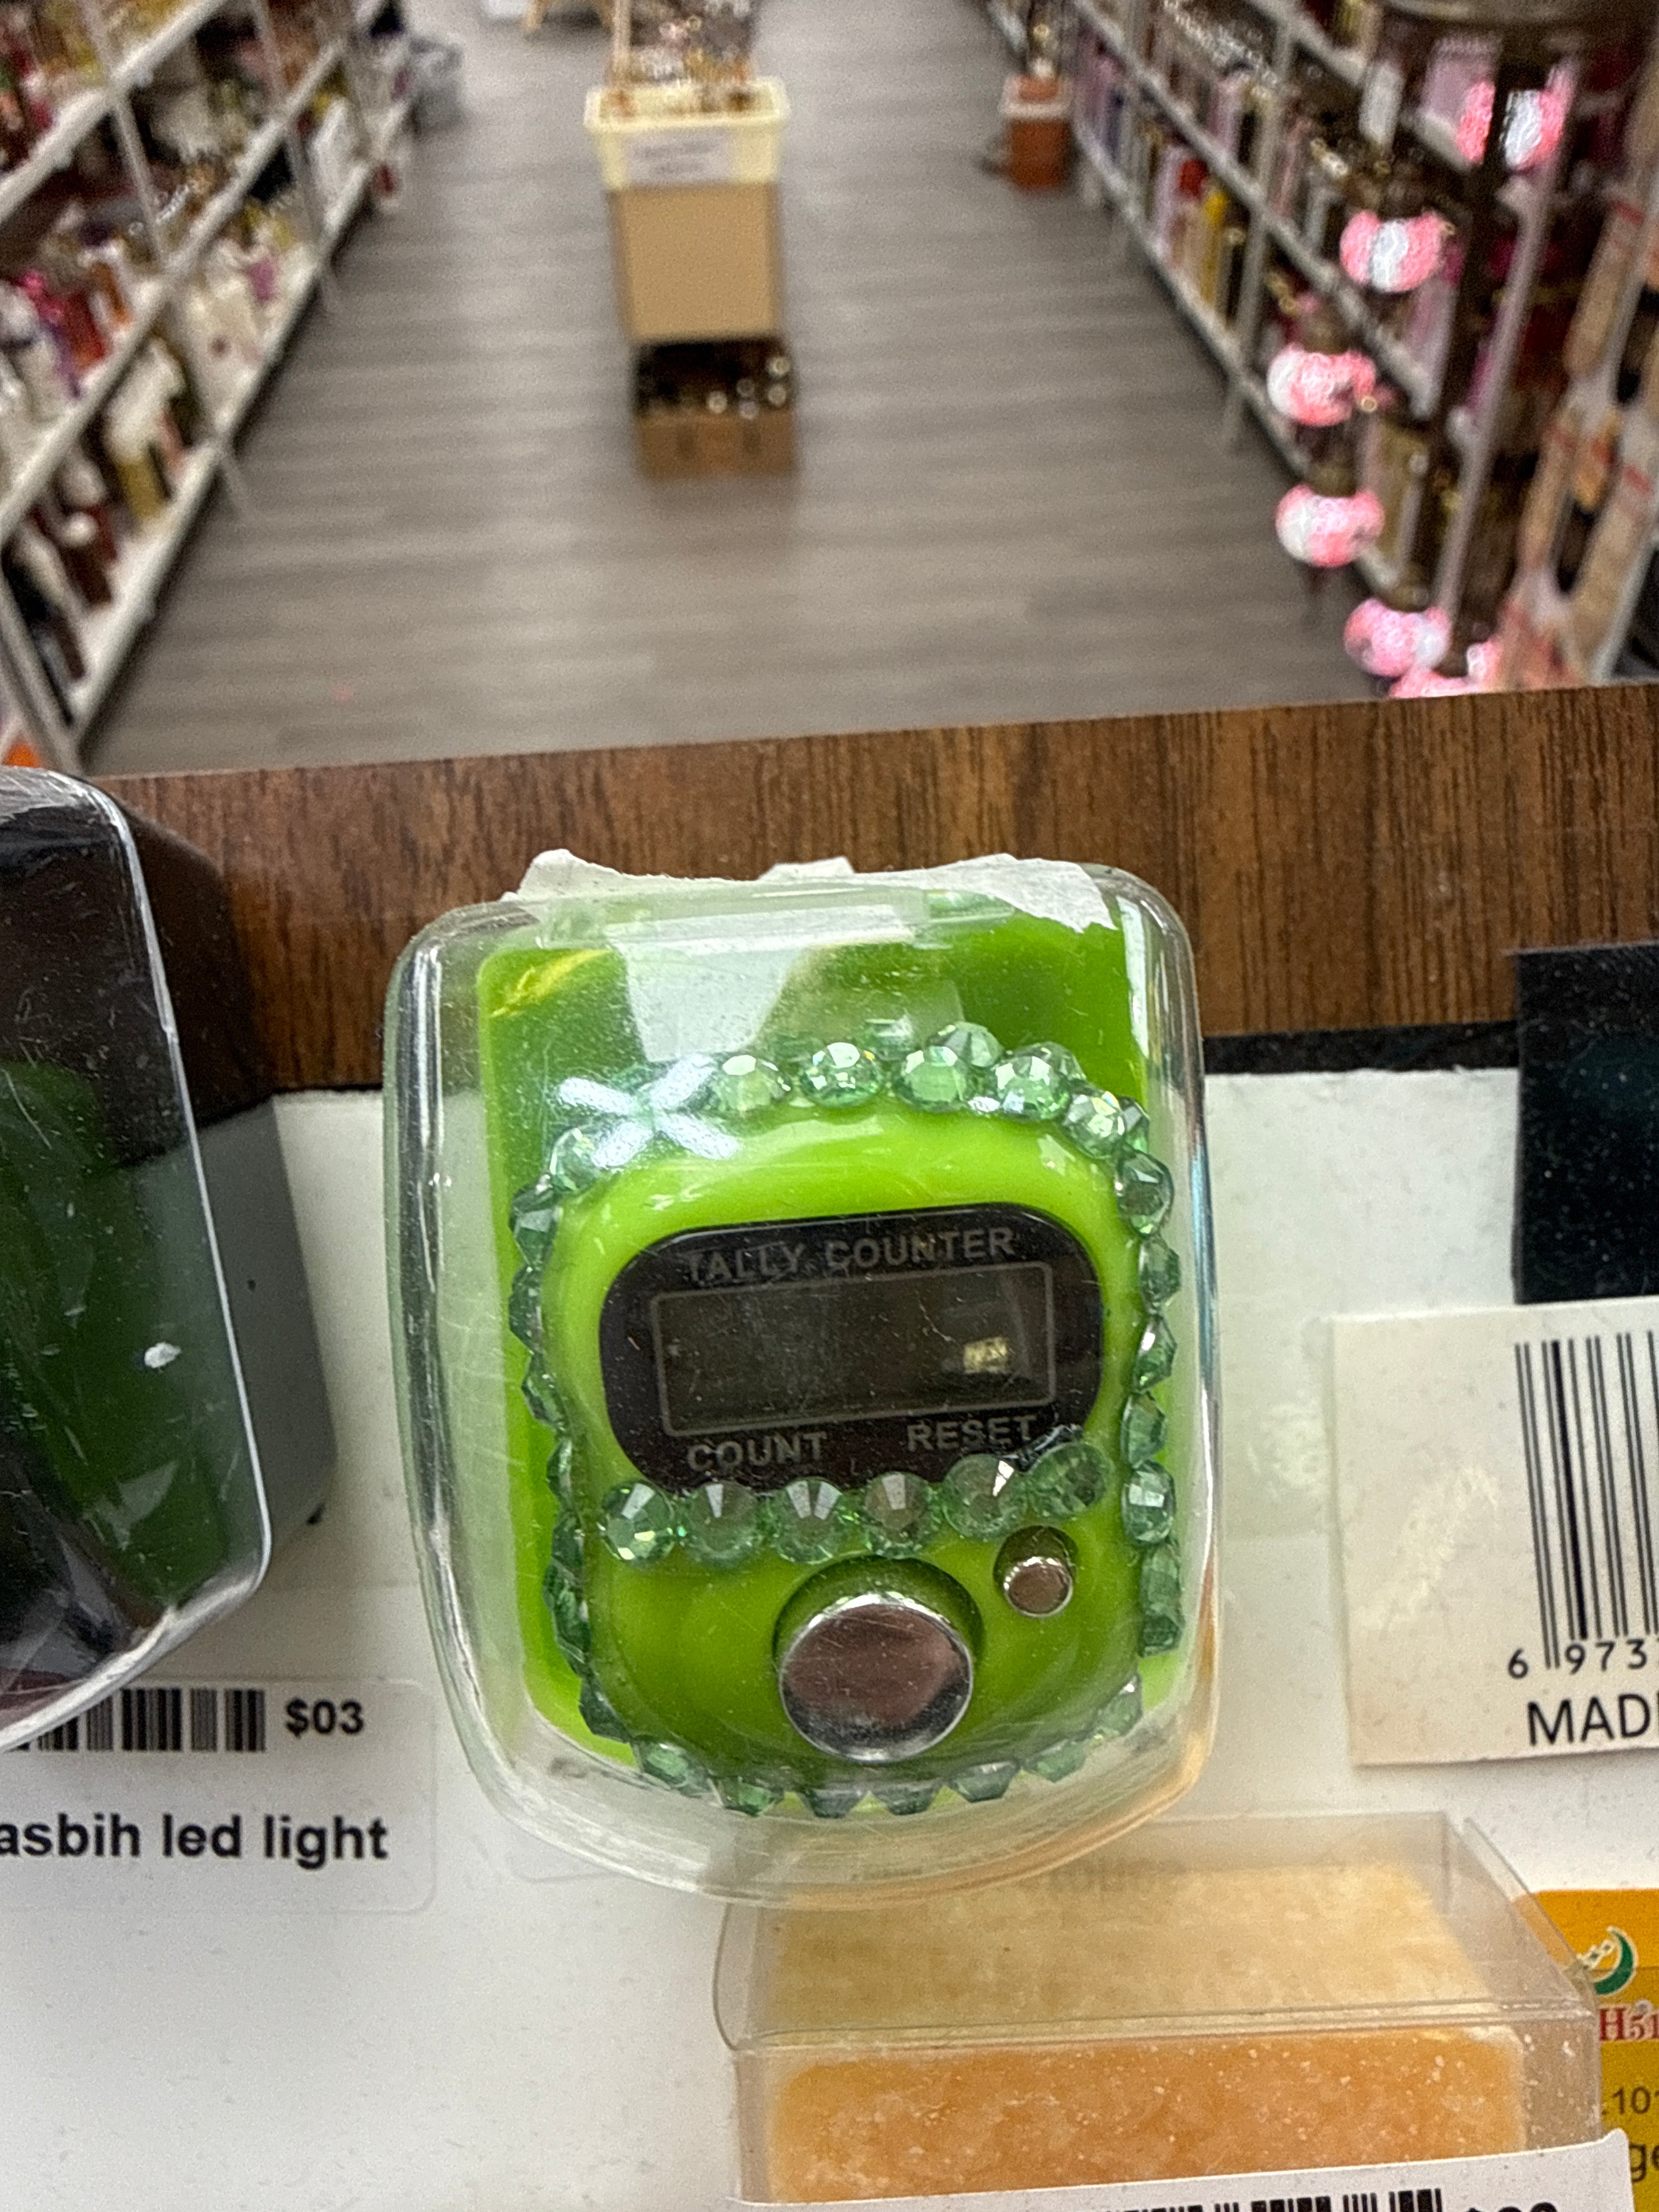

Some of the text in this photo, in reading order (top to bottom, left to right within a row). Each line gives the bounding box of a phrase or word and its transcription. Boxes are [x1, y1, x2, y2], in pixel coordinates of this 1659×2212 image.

[685, 1227, 1016, 1283] TALLY COUNTER
[687, 1431, 827, 1471] COUNT
[906, 1414, 1037, 1453] RESET
[1565, 1638, 1659, 1674] 973
[285, 1697, 364, 1737] $03
[1527, 1693, 1659, 1747] MAD
[163, 1813, 242, 1858] led
[264, 1814, 389, 1870] light
